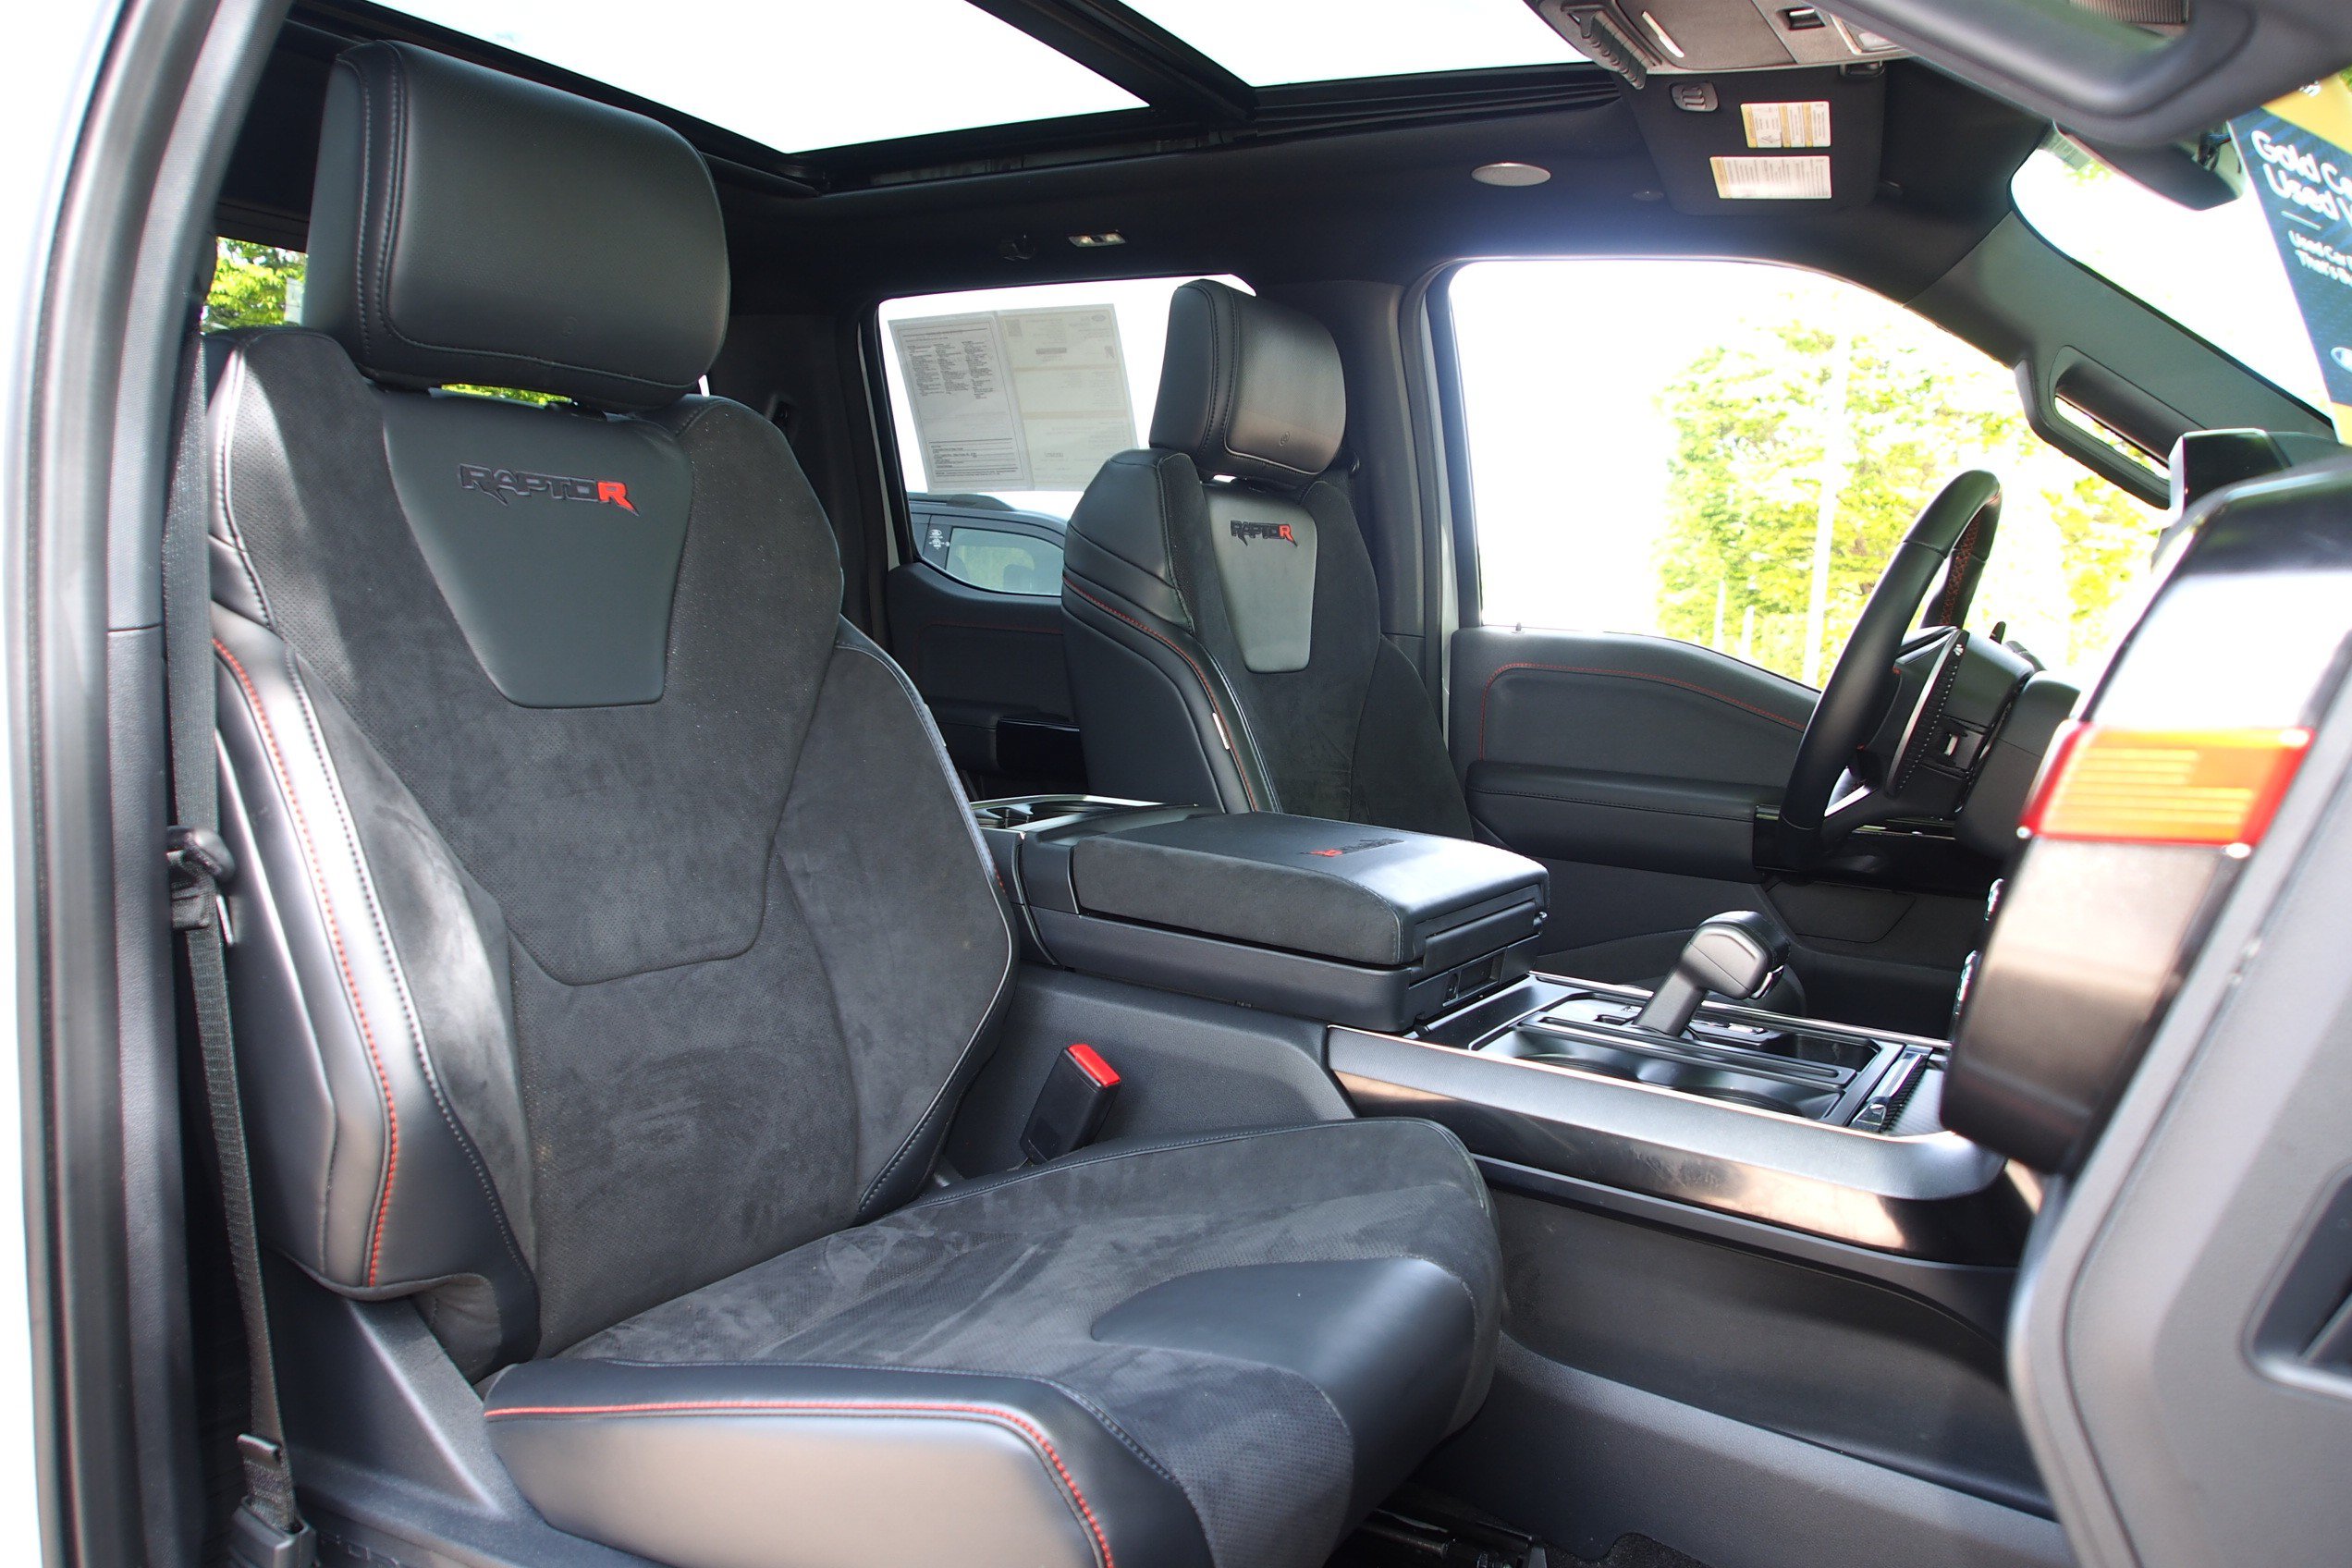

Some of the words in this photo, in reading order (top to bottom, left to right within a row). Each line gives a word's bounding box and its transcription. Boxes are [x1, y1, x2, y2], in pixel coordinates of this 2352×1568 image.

[2251, 130, 2321, 183] Gold
[2263, 164, 2340, 221] Used
[459, 463, 640, 517] RAPTOR
[1230, 520, 1298, 547] RAPTOR
